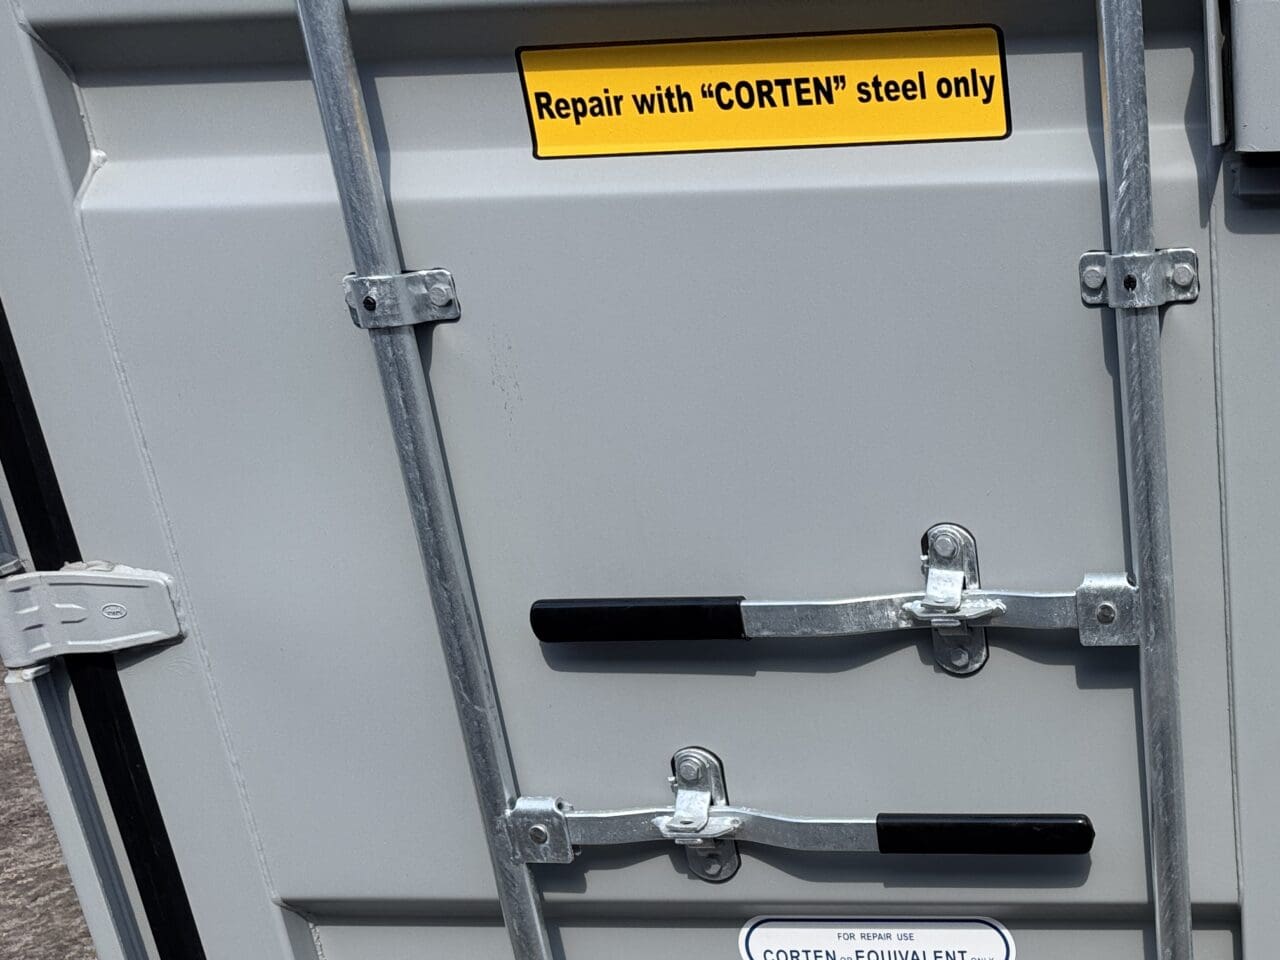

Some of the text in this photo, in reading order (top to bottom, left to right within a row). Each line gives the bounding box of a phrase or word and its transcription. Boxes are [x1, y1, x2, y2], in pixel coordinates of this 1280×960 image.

[534, 87, 624, 125] Repair
[632, 84, 694, 115] with
[857, 71, 927, 103] steel
[936, 68, 995, 105] only
[837, 932, 914, 941] FOR REPAIR USE
